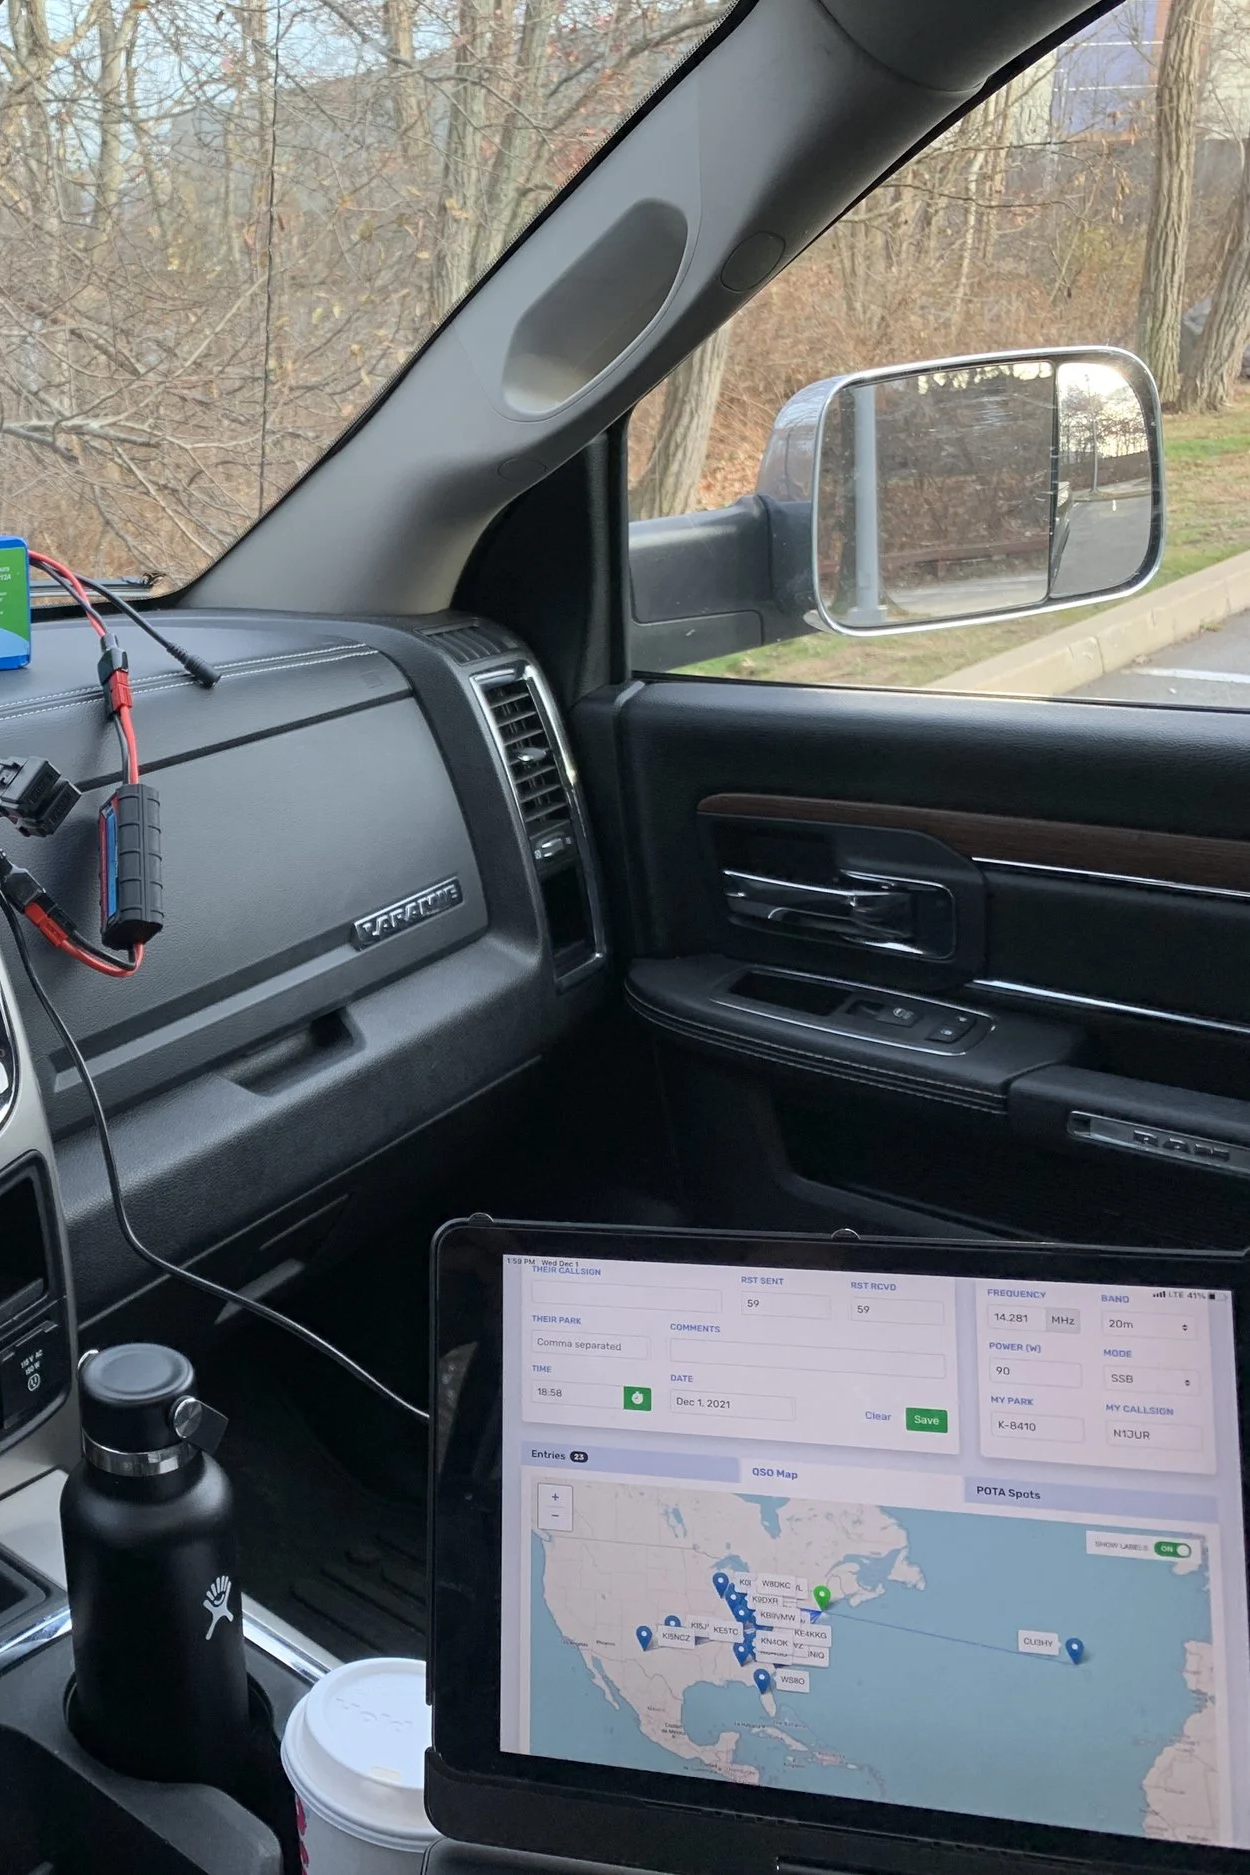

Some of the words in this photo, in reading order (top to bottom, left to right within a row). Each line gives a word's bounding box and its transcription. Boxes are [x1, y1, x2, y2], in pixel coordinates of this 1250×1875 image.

[506, 1257, 522, 1265] 1:59
[524, 1258, 536, 1266] PM
[532, 1266, 557, 1274] THEIR
[558, 1267, 601, 1276] CALLSIGN
[741, 1276, 758, 1285] RST
[760, 1277, 784, 1286] SENT
[851, 1281, 869, 1290] RST
[871, 1282, 897, 1291] RCVD
[987, 1288, 1046, 1300] FREQUENCY
[1101, 1294, 1130, 1304] BAND
[1168, 1291, 1184, 1299] LTE
[747, 1299, 760, 1308] 59
[857, 1305, 870, 1314] 59
[532, 1315, 557, 1324] THEIR
[559, 1316, 582, 1325] PARK
[994, 1312, 1028, 1323] 14.281
[1051, 1315, 1075, 1326] MHz
[1108, 1319, 1134, 1329] 20m
[669, 1323, 721, 1333] COMMENTS
[537, 1337, 572, 1348] Comma
[575, 1341, 622, 1352] separated
[989, 1342, 1023, 1352] POWER
[1025, 1343, 1042, 1354] (W)
[1103, 1348, 1132, 1359] MODE
[532, 1364, 552, 1373] TIME
[995, 1366, 1011, 1376] 90
[670, 1374, 694, 1383] DATE
[1110, 1373, 1134, 1384] SSB
[537, 1387, 563, 1398] 18:58
[676, 1397, 696, 1407] Dec
[706, 1399, 731, 1409] 2021
[990, 1395, 1006, 1404] MY
[1007, 1396, 1034, 1407] PARK
[1105, 1403, 1121, 1413] MY
[1122, 1405, 1174, 1416] CALLSIGN
[865, 1411, 892, 1421] Clear
[914, 1415, 940, 1426] Save
[998, 1420, 1036, 1432] K-8410
[1113, 1429, 1151, 1440] N1JUR
[531, 1449, 566, 1460] Entries
[573, 1453, 586, 1461] 23
[752, 1467, 774, 1478] QSO
[776, 1470, 798, 1481] Map
[976, 1485, 1006, 1497] POTA
[1008, 1489, 1041, 1500] Spots
[1095, 1541, 1118, 1549] SHOW
[1120, 1543, 1148, 1551] LABELS
[762, 1580, 791, 1589] W8DKC
[713, 1626, 738, 1636] KE5TC
[662, 1633, 690, 1642] KI5NCZ
[1023, 1637, 1053, 1648] CU3HY
